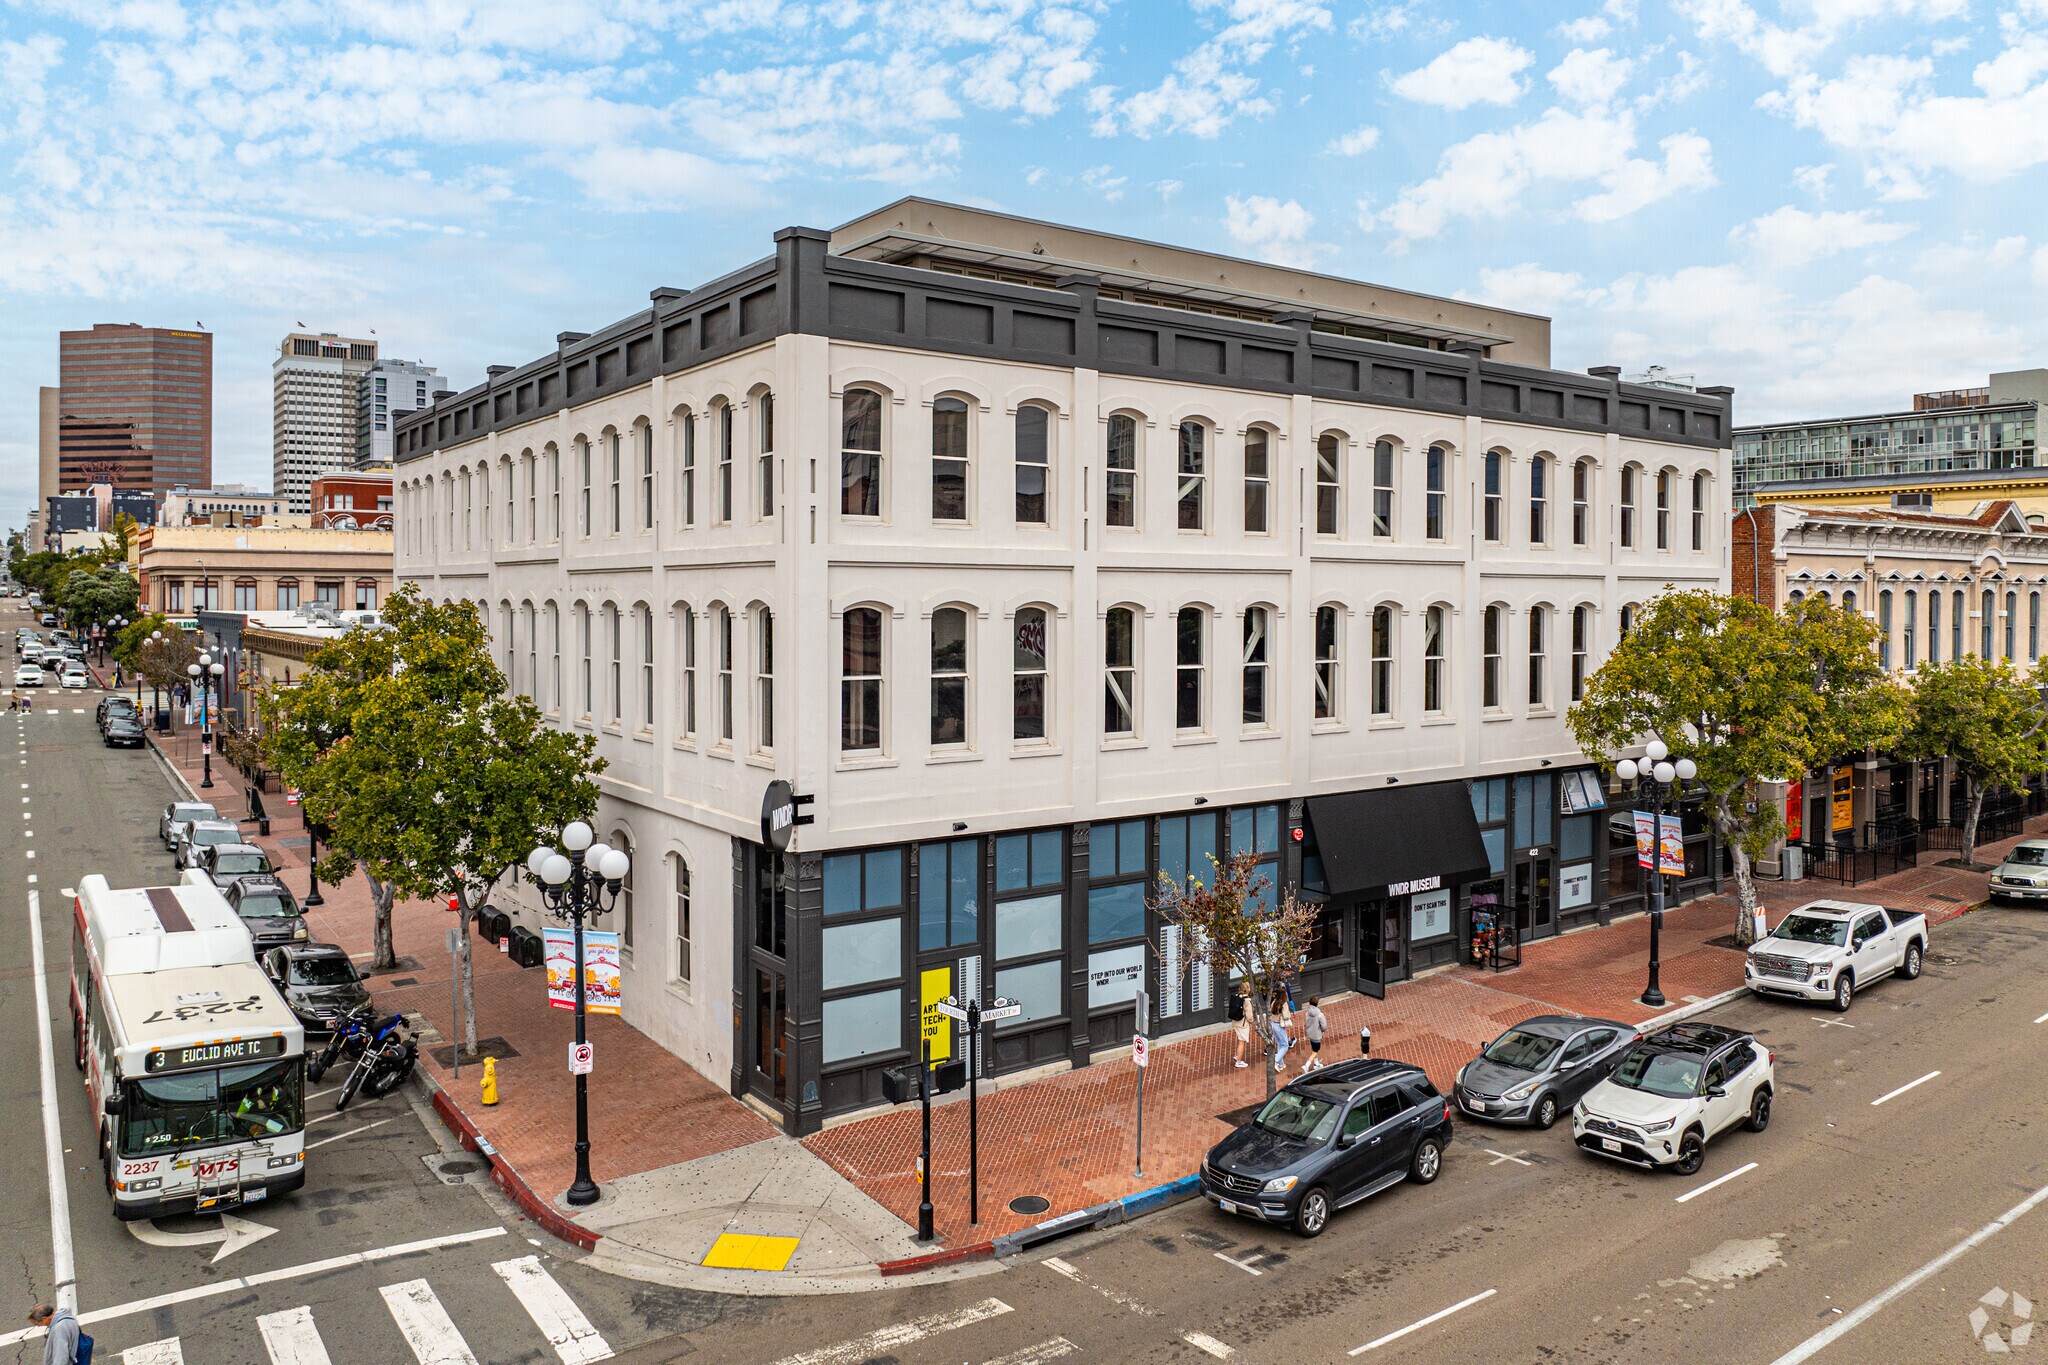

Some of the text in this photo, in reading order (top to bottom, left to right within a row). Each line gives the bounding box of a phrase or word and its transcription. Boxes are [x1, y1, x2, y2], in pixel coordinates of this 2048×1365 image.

[772, 803, 793, 832] WNDR
[1529, 848, 1539, 856] 422
[1388, 875, 1441, 897] WNDR MUSEUM
[1414, 899, 1447, 912] DON'T SCAN THIS
[1090, 964, 1143, 981] STEP INTO OUR WORLD
[923, 1003, 938, 1015] ART
[984, 1008, 1011, 1020] MARKET
[923, 1014, 946, 1026] TECH+
[923, 1026, 938, 1037] YOU
[155, 1040, 261, 1067] 3 EUCLID AVE TC
[152, 1133, 172, 1144] 2.50
[124, 1160, 160, 1175] 2237
[193, 1158, 238, 1177] MTS
